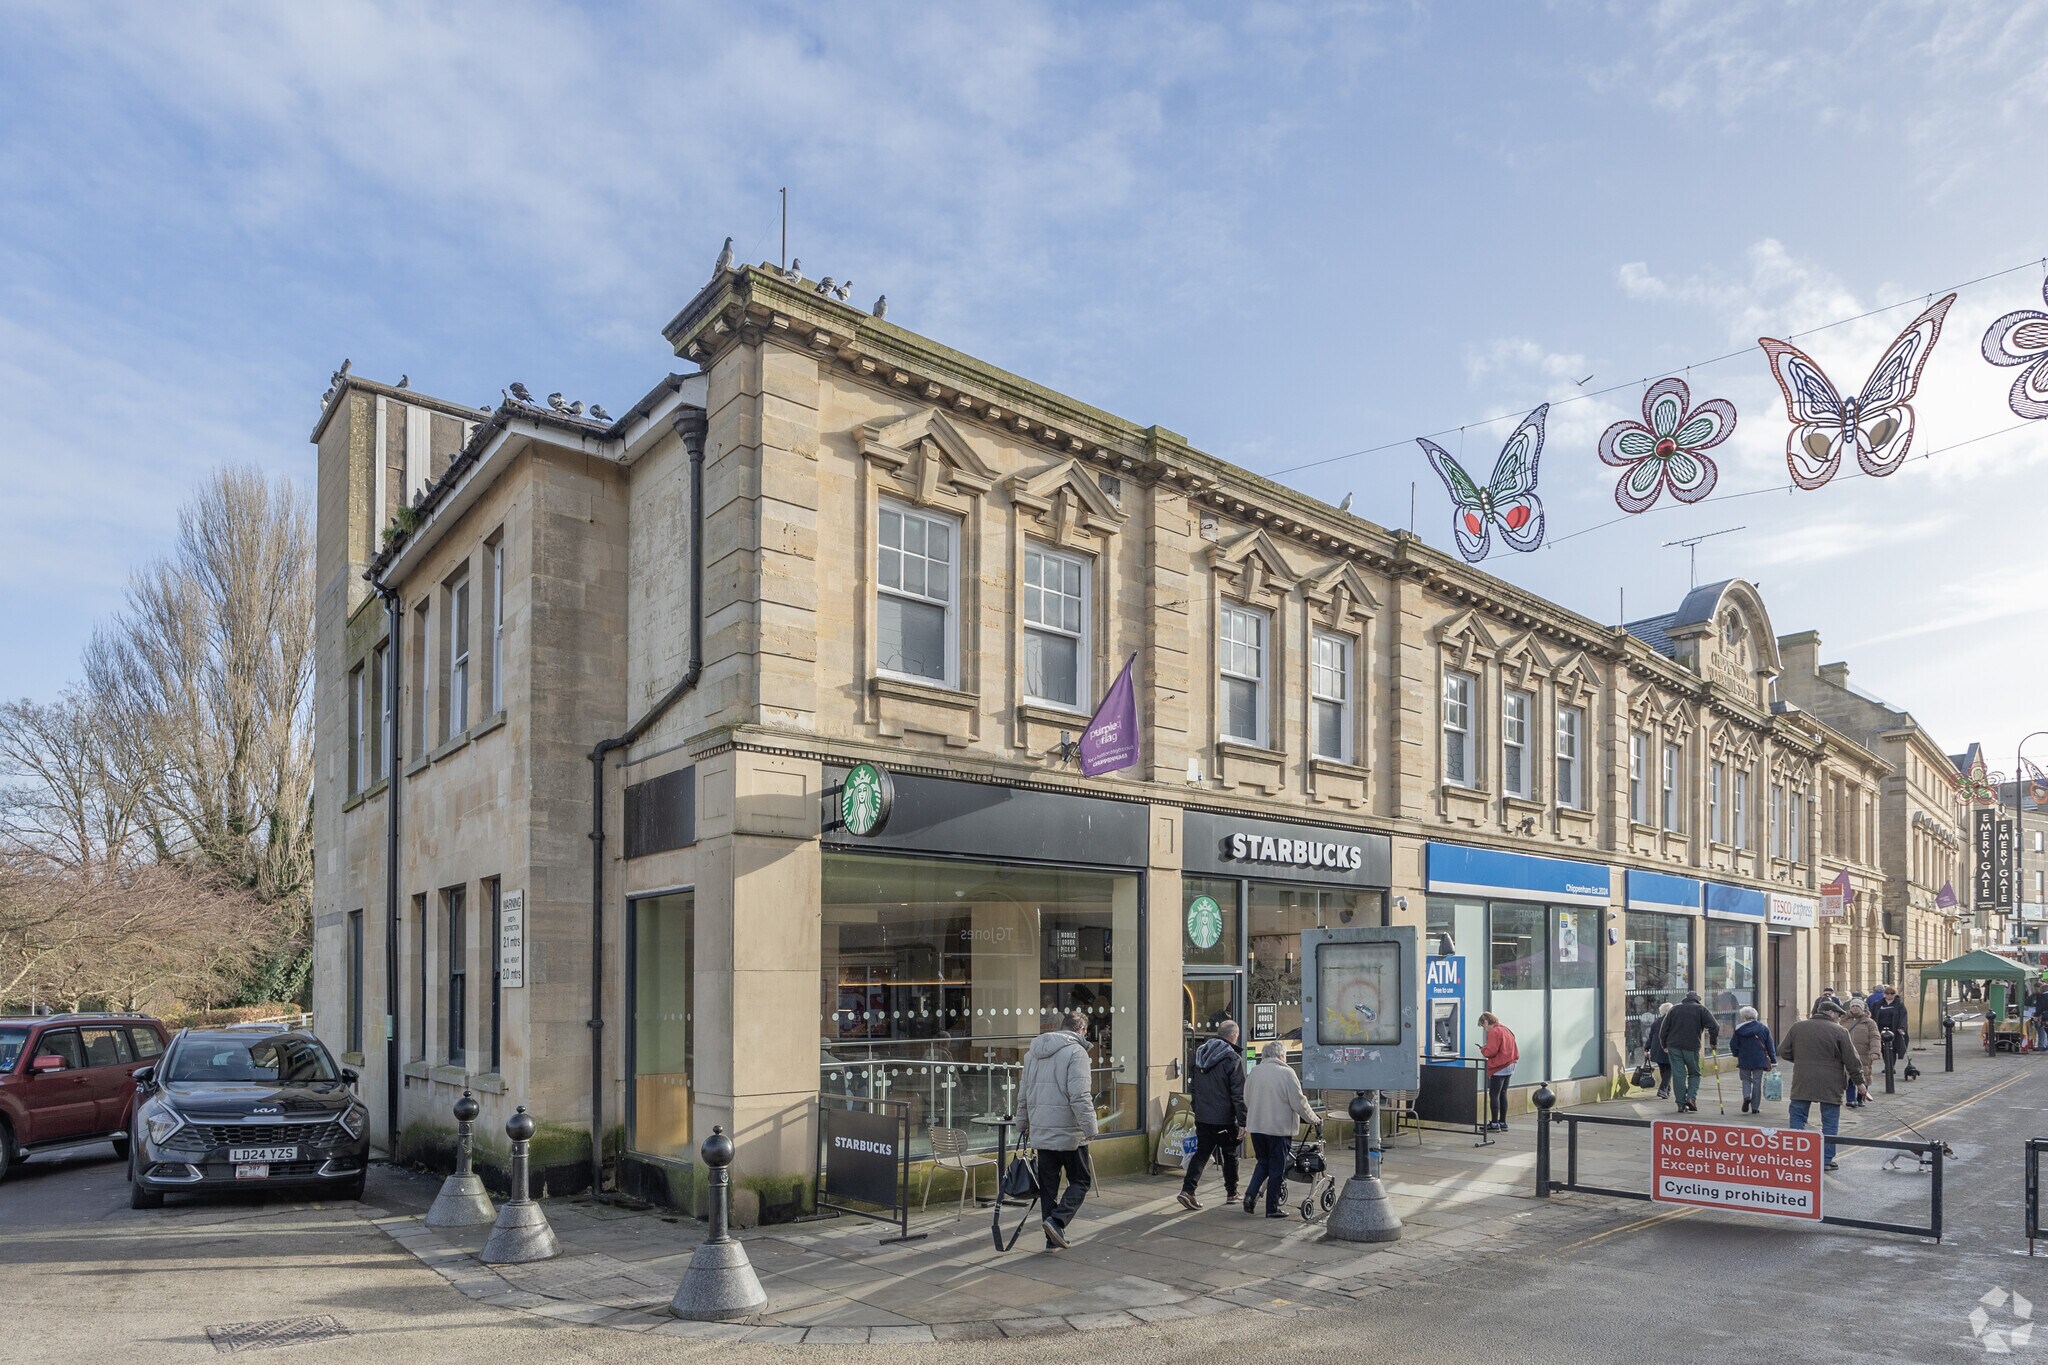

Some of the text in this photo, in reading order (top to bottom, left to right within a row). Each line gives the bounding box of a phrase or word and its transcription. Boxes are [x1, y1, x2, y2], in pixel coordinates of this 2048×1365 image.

[1232, 832, 1362, 870] STARBUCKS
[1980, 813, 1992, 898] EMERY GATE
[1998, 824, 2009, 866] EMERY
[1565, 883, 1592, 894] Chippenham
[1998, 869, 2009, 903] GATE
[503, 896, 521, 910] WARNING
[1773, 899, 1813, 918] TESCO express
[1433, 986, 1442, 994] Free
[1256, 1023, 1267, 1031] PICK
[1258, 1014, 1273, 1022] ORDER
[835, 1136, 892, 1156] STARBUCKS
[1662, 1127, 1811, 1151] ROAD CLOSED
[234, 1148, 293, 1161] LD24 YZS
[1661, 1143, 1813, 1168] No delivery vehicles
[1661, 1158, 1812, 1183] Except Bullion Vans
[1664, 1181, 1807, 1207] Cycling prohibited
